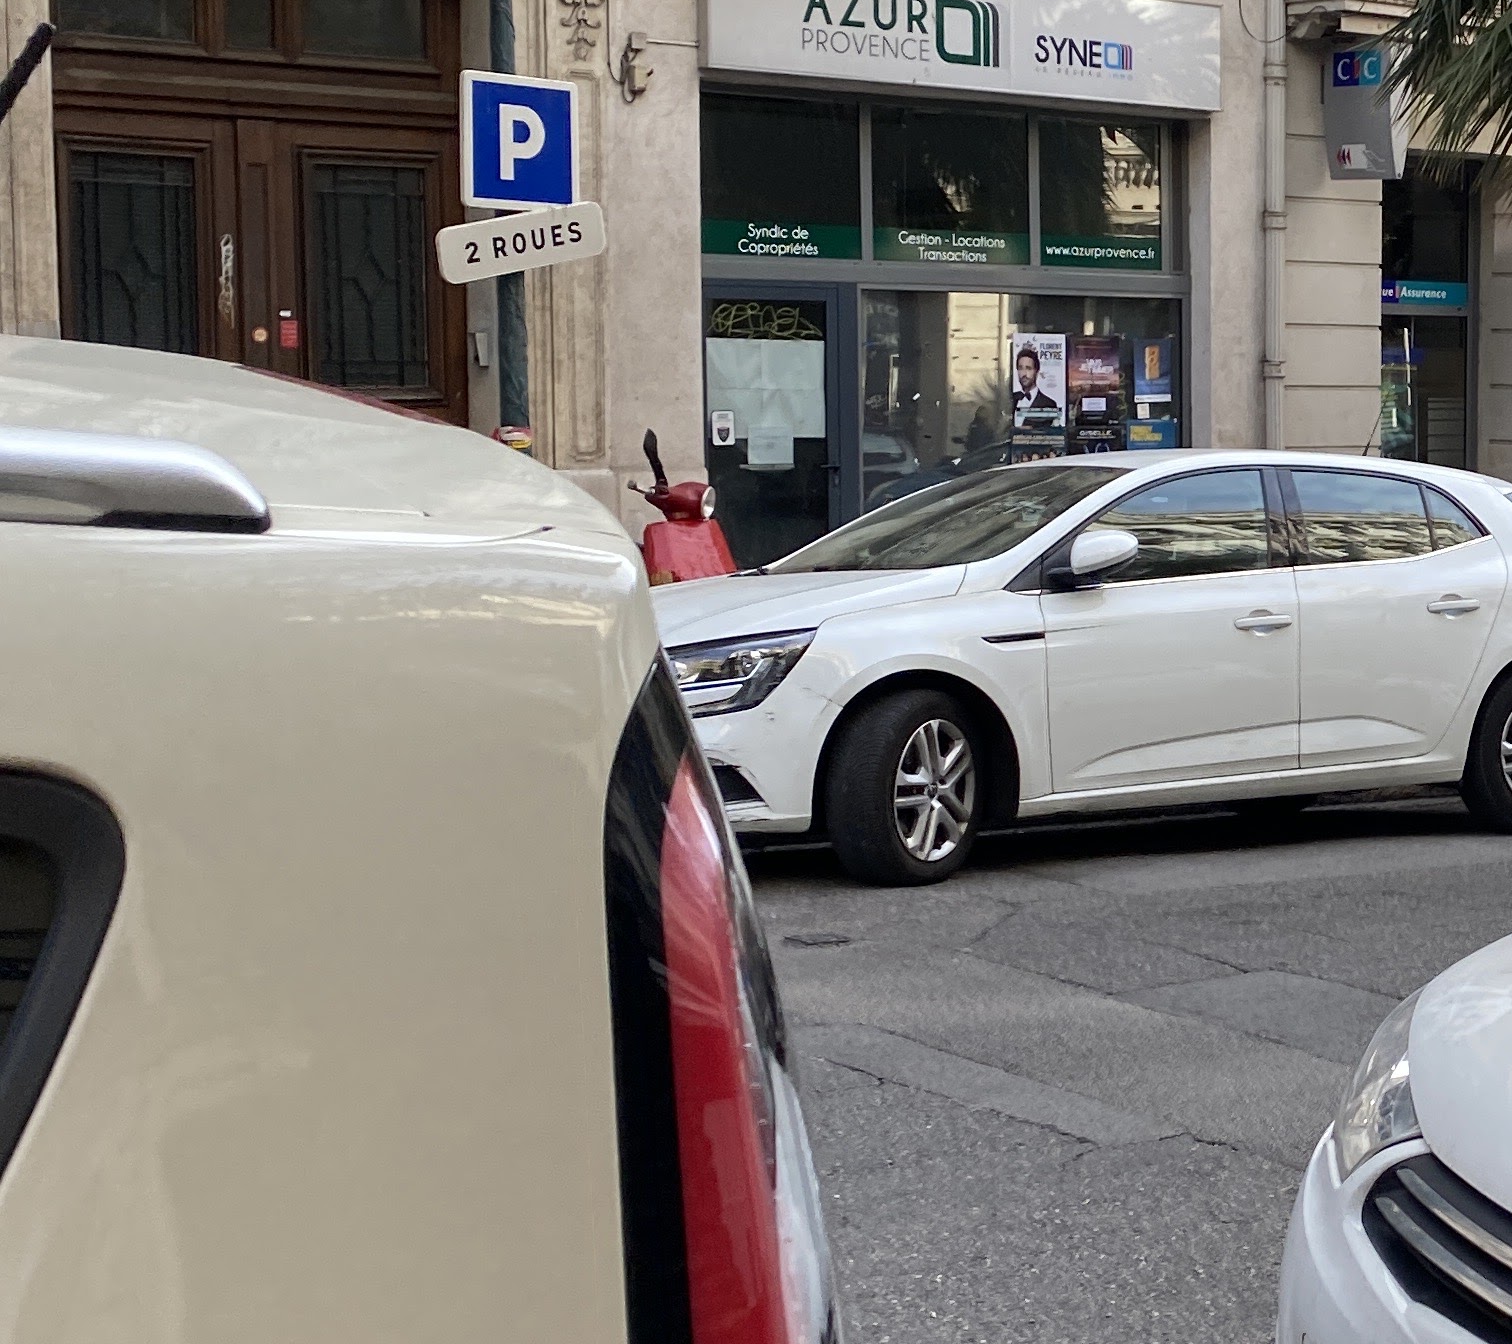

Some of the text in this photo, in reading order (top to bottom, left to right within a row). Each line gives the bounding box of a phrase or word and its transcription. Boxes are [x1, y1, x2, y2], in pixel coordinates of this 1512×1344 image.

[801, 27, 931, 63] PROVENCE
[1337, 56, 1378, 81] CIC
[498, 103, 546, 181] P
[747, 223, 810, 241] Syndic de
[898, 230, 942, 247] Gestion
[952, 233, 1006, 249] Locations
[464, 221, 582, 264] 2 ROUES
[737, 239, 819, 256] Copropriétés
[917, 247, 988, 263] Transactions
[1045, 244, 1156, 260] www.azurprovence.fr
[1400, 286, 1447, 299] Assurance
